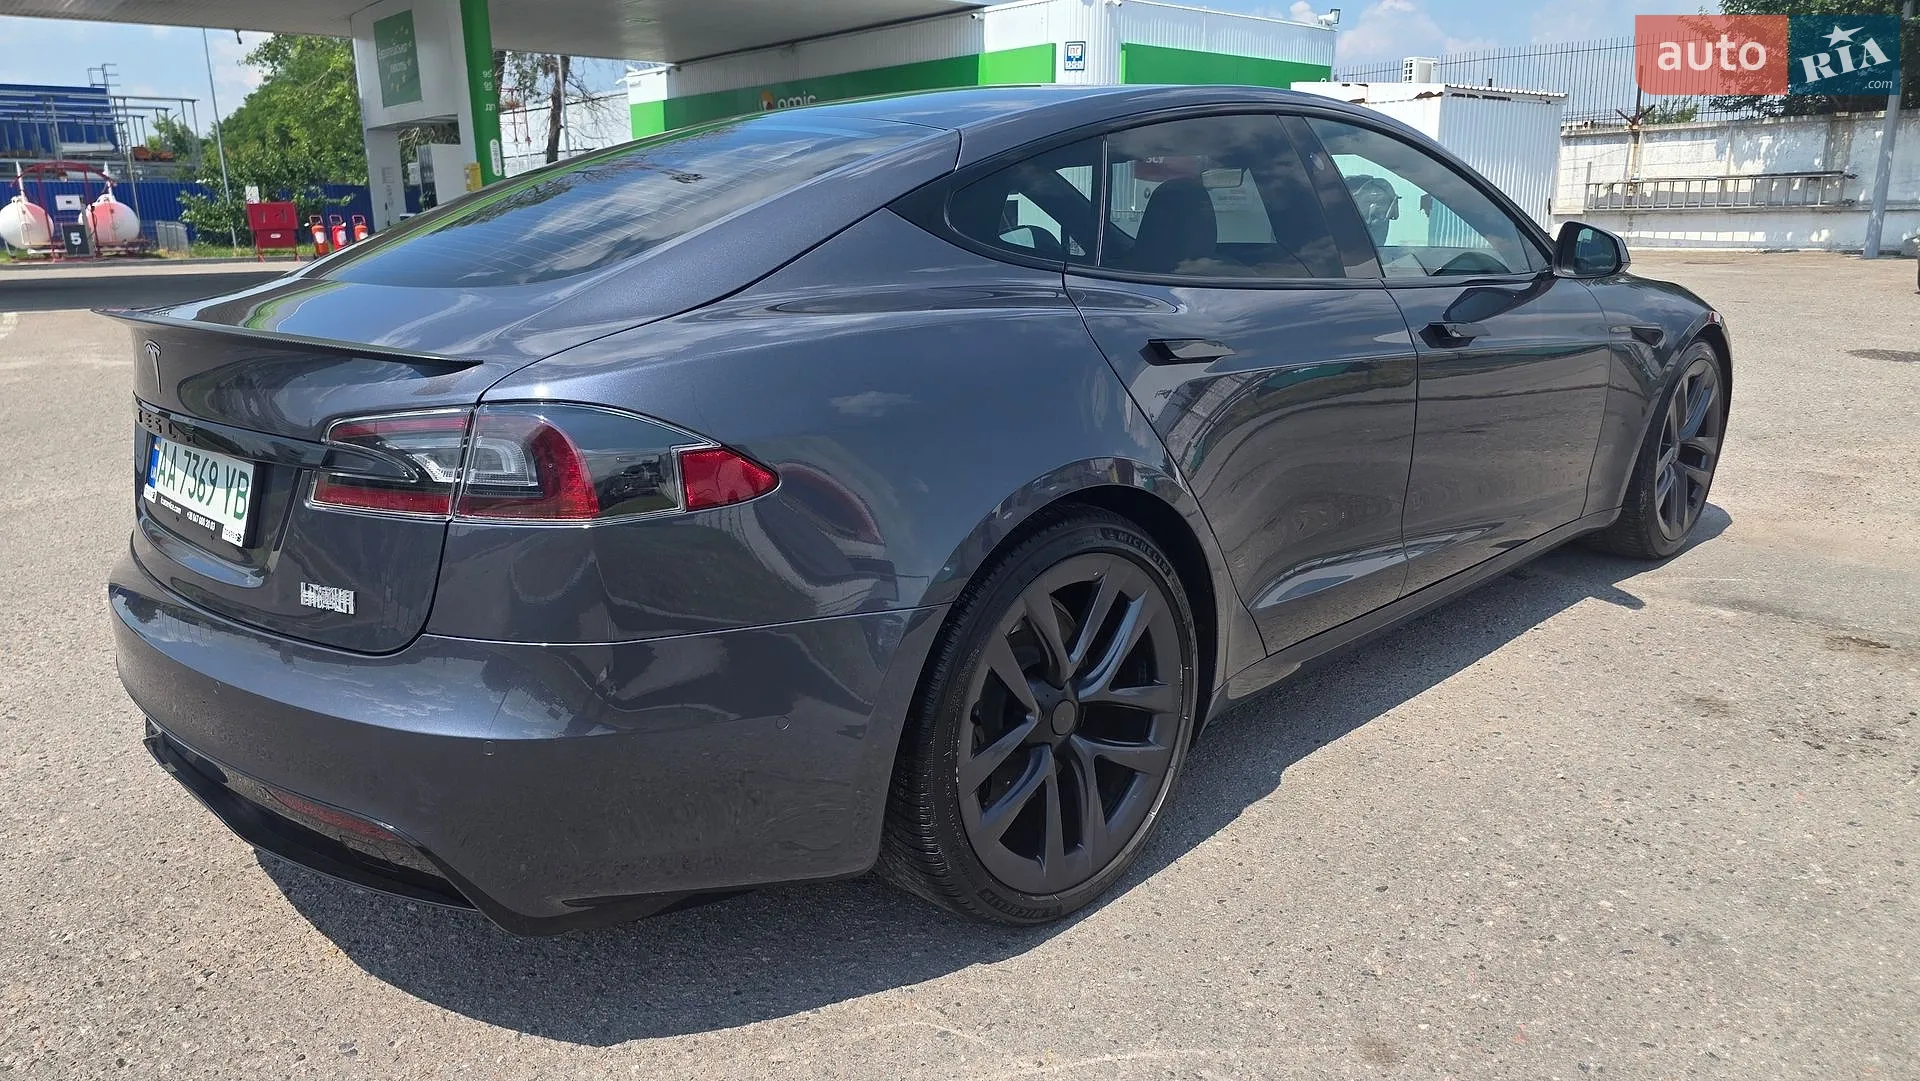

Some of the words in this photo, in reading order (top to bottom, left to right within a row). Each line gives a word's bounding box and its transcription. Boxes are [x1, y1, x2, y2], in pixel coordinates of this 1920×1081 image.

[70, 231, 82, 245] 5
[157, 442, 177, 492] AA
[179, 449, 219, 506] 7369
[223, 464, 250, 521] YB
[1118, 532, 1169, 574] MICHELIN
